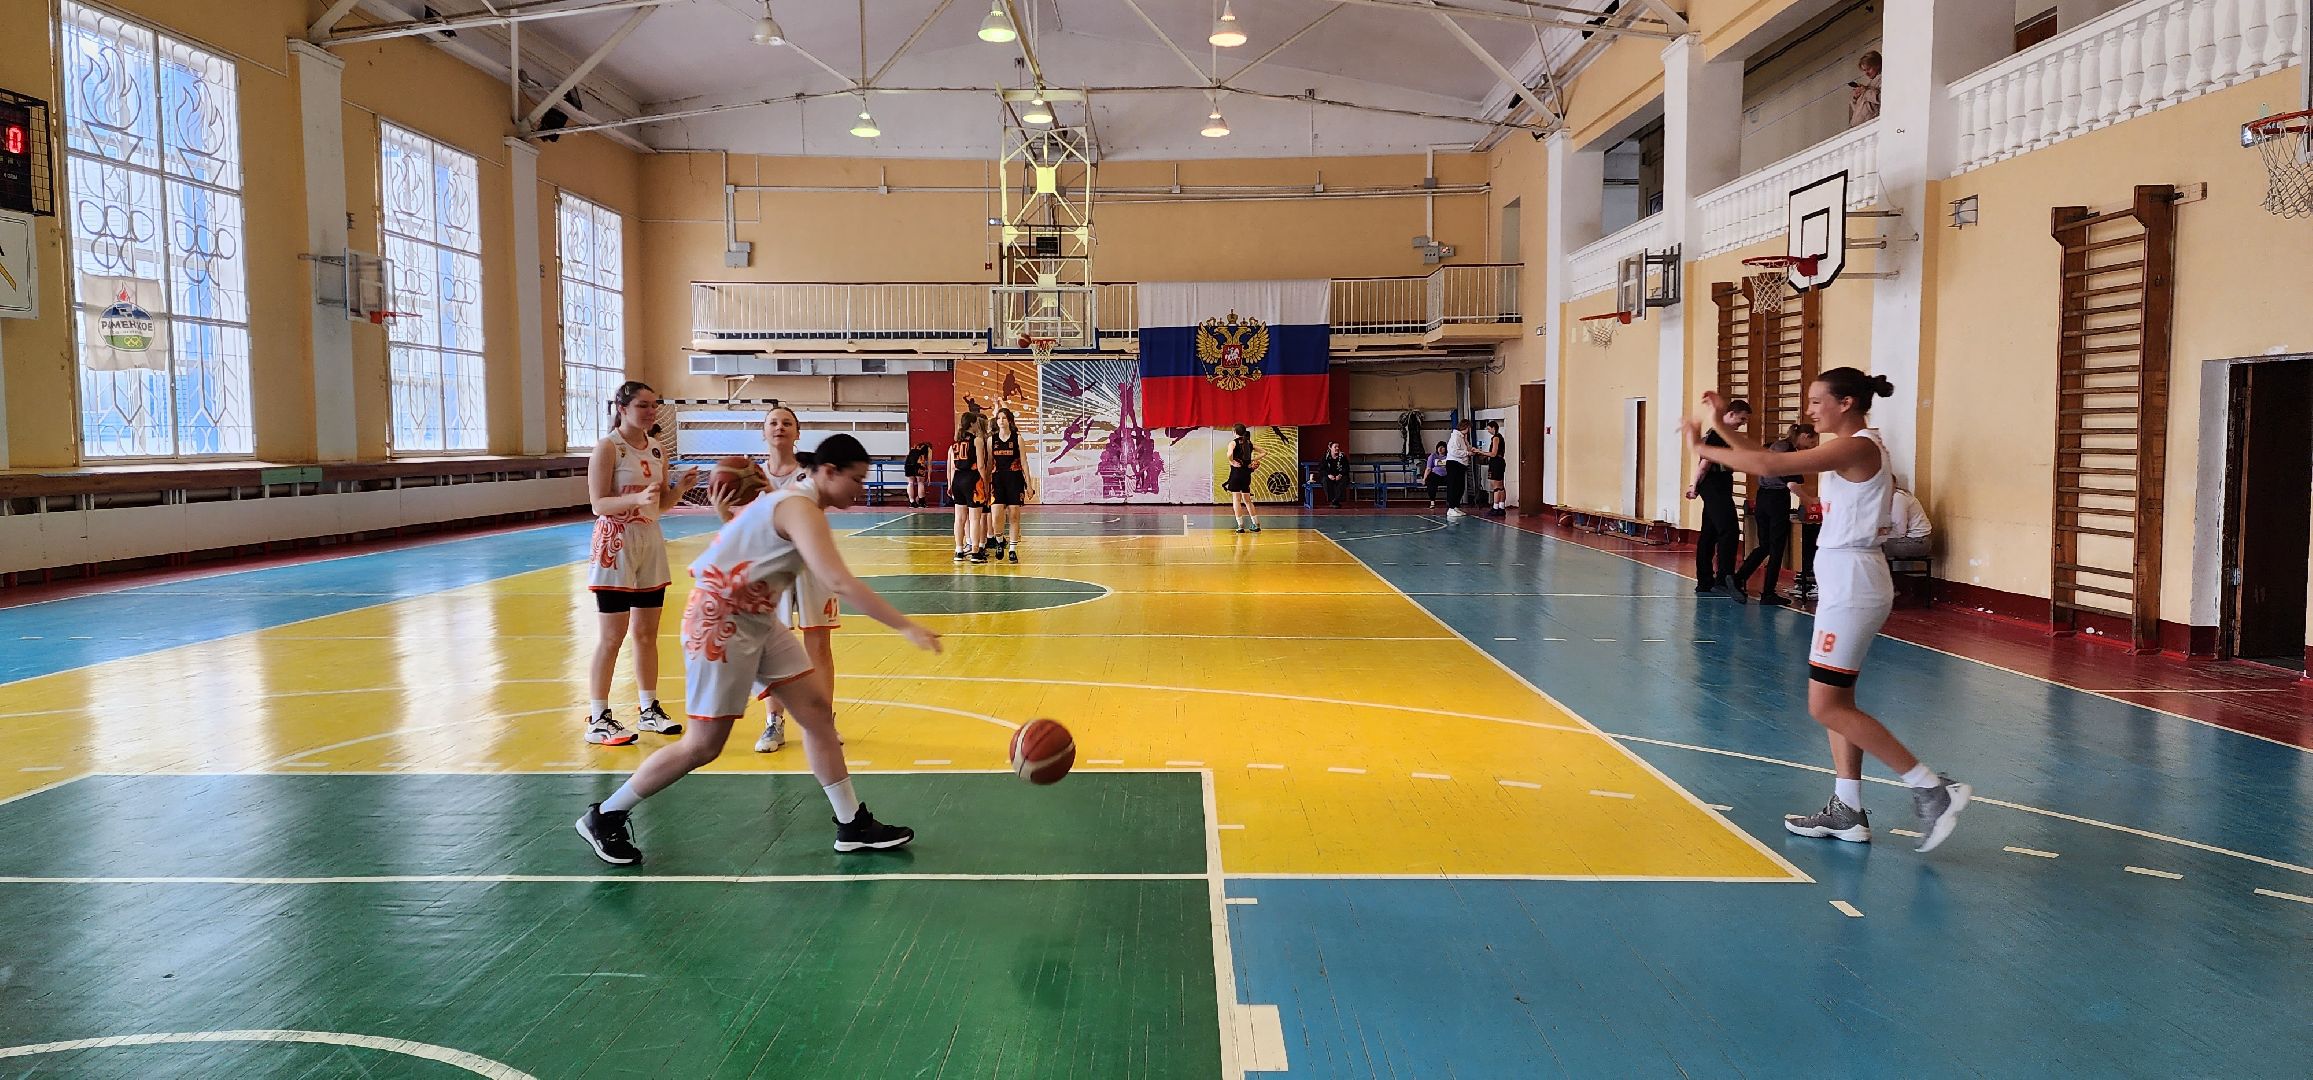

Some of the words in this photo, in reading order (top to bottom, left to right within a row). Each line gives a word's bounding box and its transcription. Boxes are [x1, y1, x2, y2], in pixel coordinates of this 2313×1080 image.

[101, 320, 153, 331] РМЕНКОЕ
[640, 460, 651, 478] 3
[1816, 630, 1836, 652] 18
